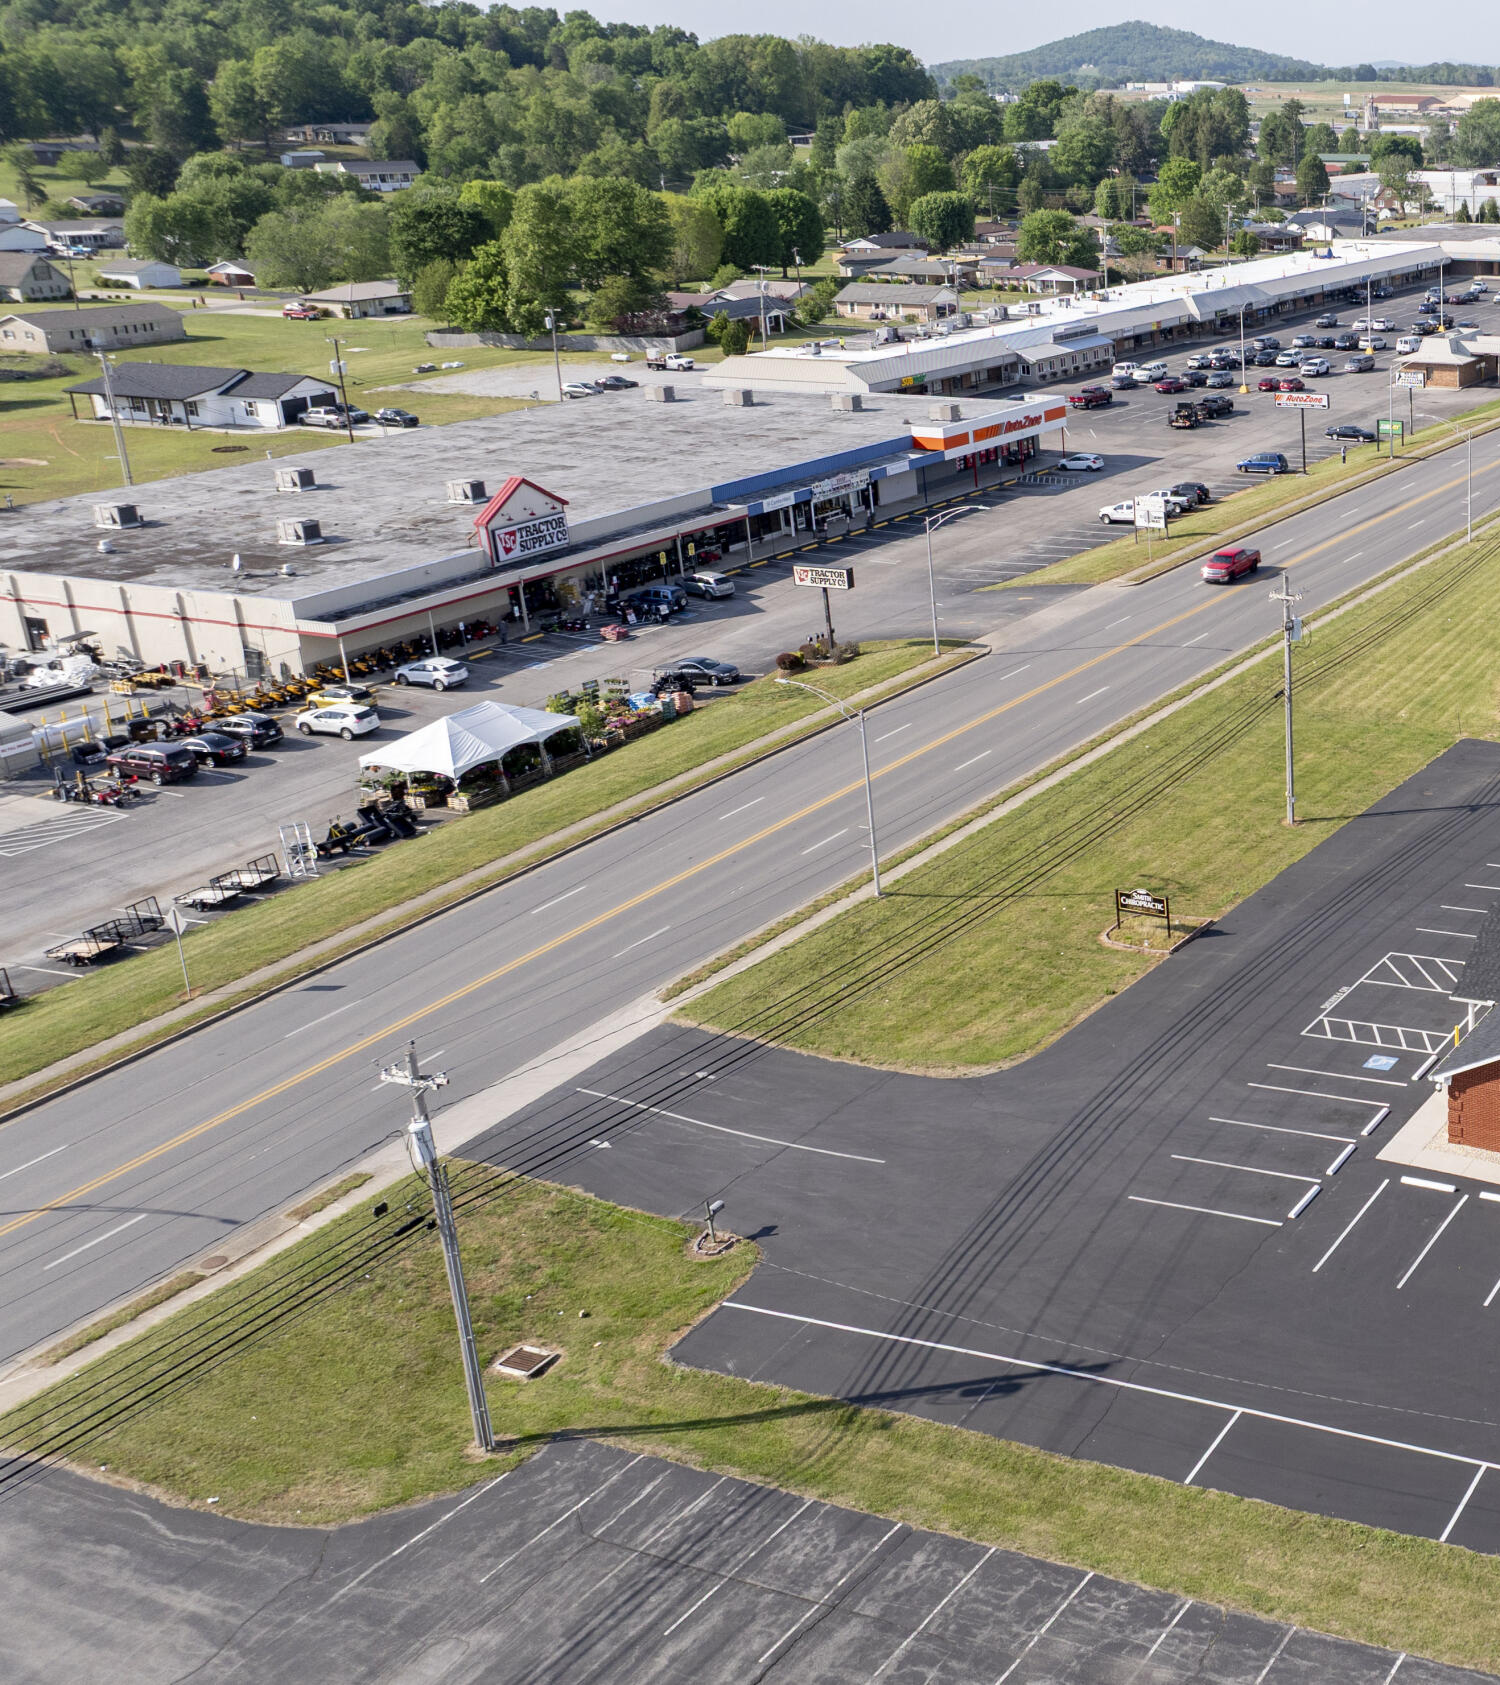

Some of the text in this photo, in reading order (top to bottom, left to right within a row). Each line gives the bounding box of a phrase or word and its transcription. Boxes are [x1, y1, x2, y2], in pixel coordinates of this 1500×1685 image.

[1286, 395, 1323, 403] AutoZone
[1003, 414, 1043, 434] AutoZone
[517, 516, 566, 539] TRACTOR
[520, 533, 556, 552] SUPPLY
[810, 569, 845, 578] TRACTOR
[810, 577, 837, 586] SUPPLY
[1121, 896, 1165, 910] CHIROPRACTIC
[1132, 892, 1152, 902] SMITH
